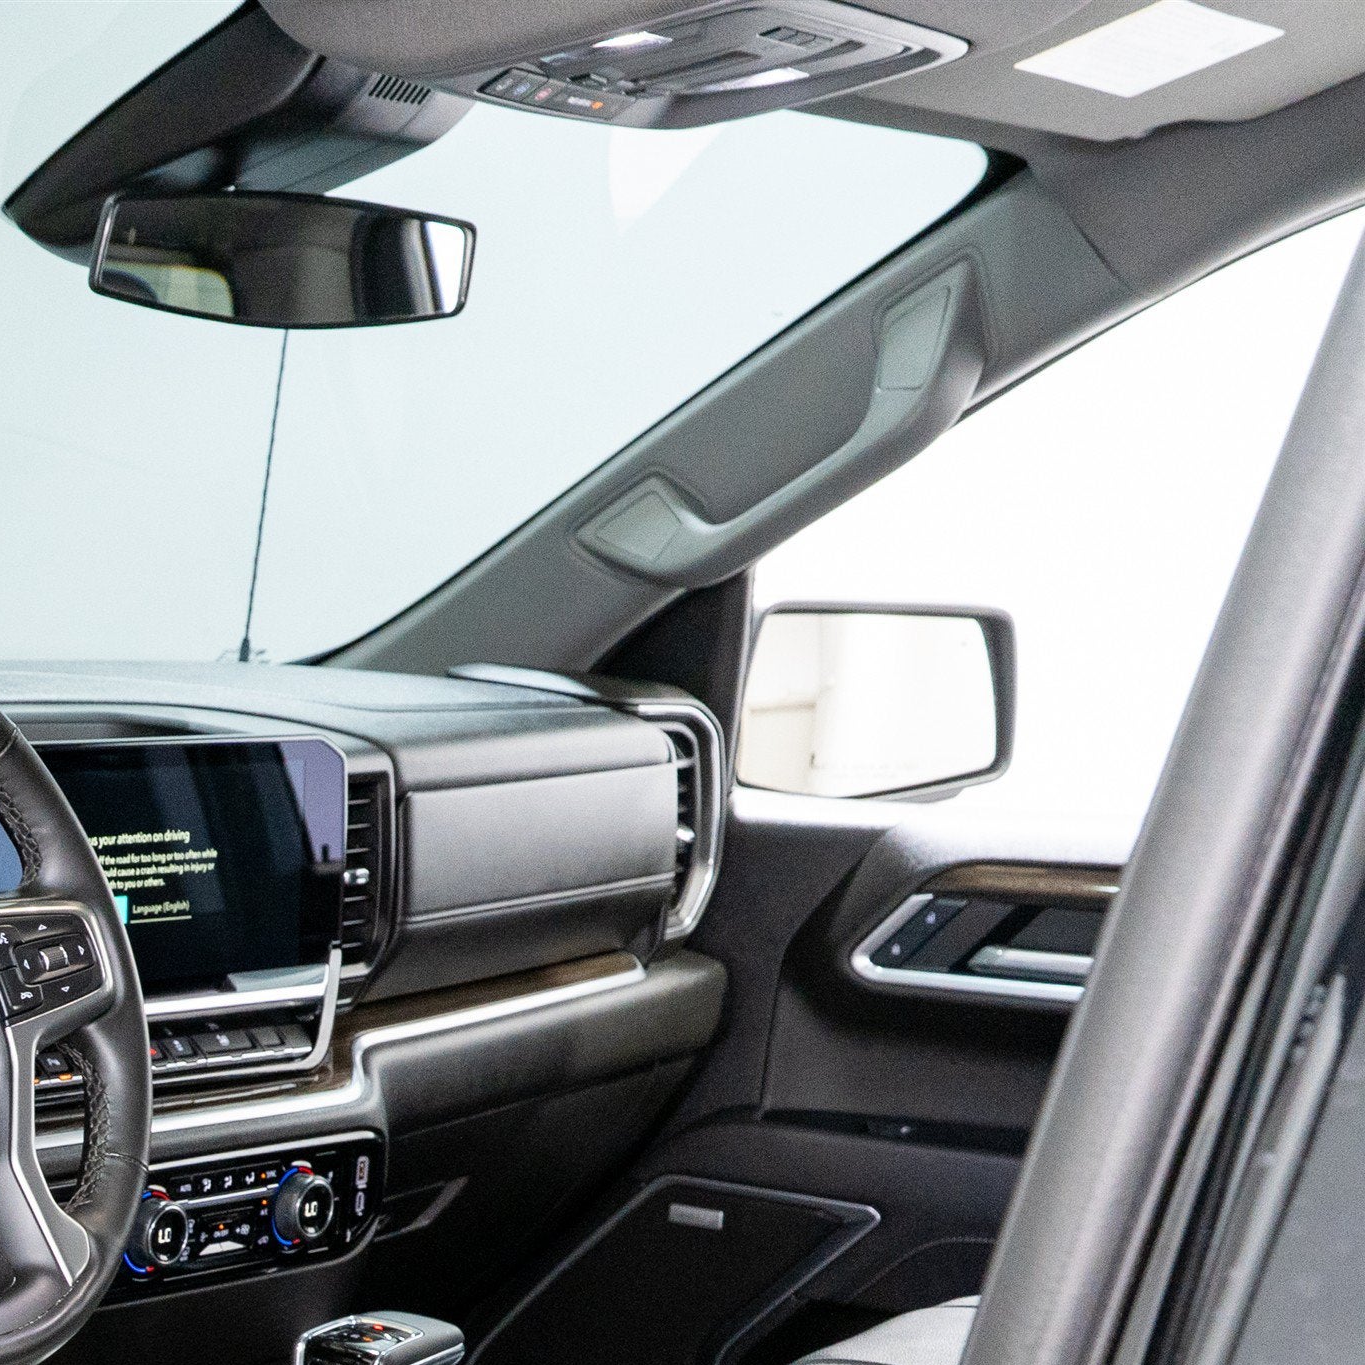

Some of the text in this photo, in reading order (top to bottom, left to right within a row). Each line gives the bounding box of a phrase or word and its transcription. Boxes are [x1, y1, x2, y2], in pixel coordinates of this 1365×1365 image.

[99, 836, 116, 849] your
[117, 832, 152, 845] attention
[153, 833, 163, 842] on
[164, 829, 190, 843] driving
[105, 855, 115, 865] the
[116, 853, 131, 864] road
[131, 853, 140, 863] for
[152, 852, 166, 864] long
[185, 849, 201, 859] often
[202, 848, 217, 858] while
[118, 868, 135, 877] cause
[141, 865, 157, 875] crash
[158, 863, 183, 875] resulting
[124, 881, 136, 891] you
[132, 904, 162, 915] Language
